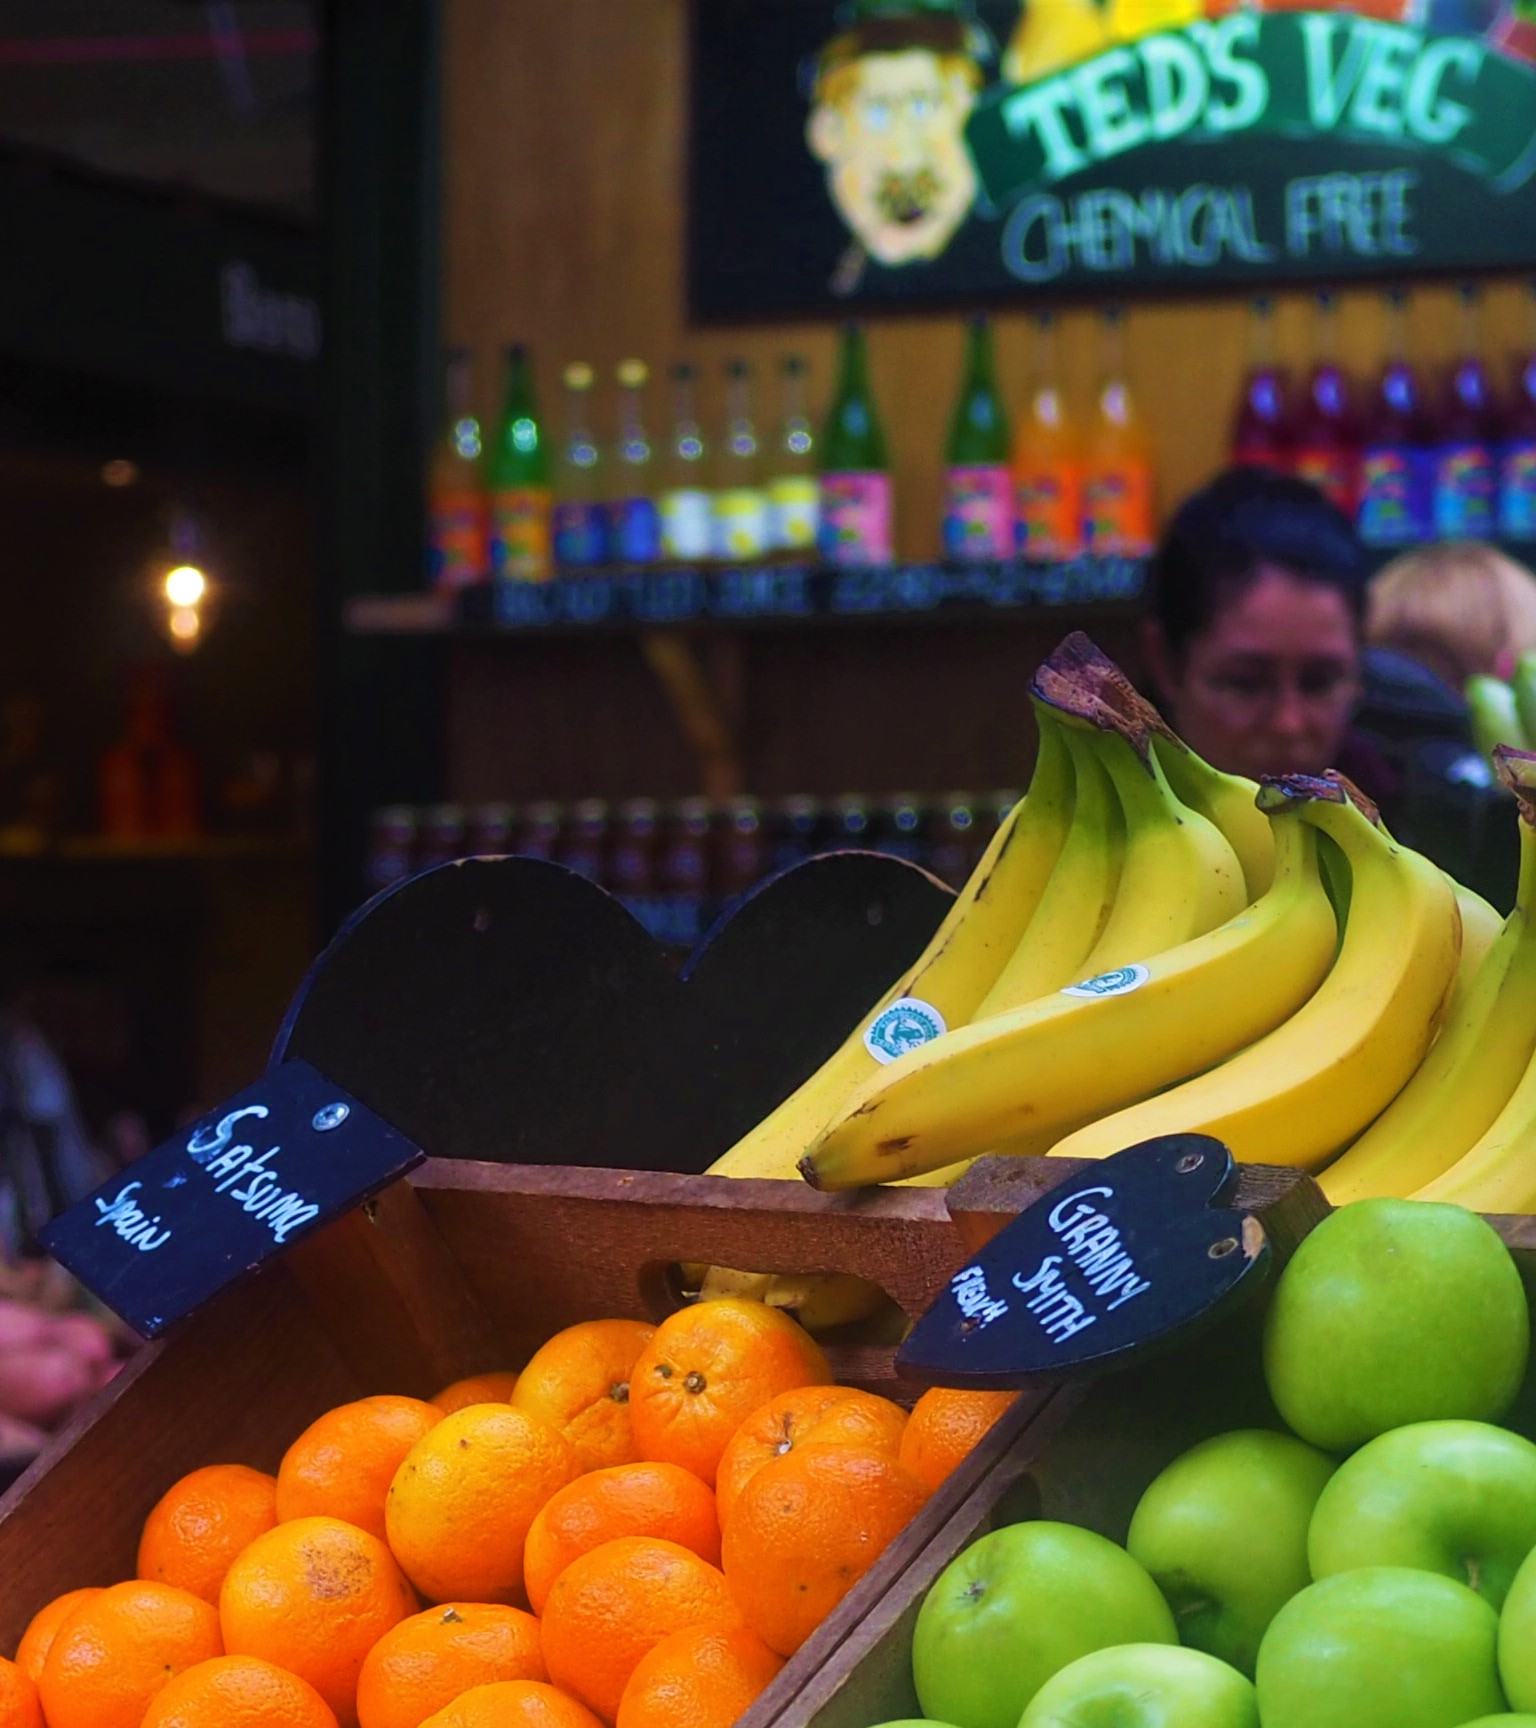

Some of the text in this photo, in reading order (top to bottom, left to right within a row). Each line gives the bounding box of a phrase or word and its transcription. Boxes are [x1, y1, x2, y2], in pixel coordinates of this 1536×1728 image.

[1299, 13, 1486, 144] VEG
[1001, 168, 1420, 283] CHEMICAL FREE
[95, 1181, 171, 1251] Spain
[1048, 1186, 1153, 1311] GRANNY
[1012, 1255, 1097, 1344] SMITH
